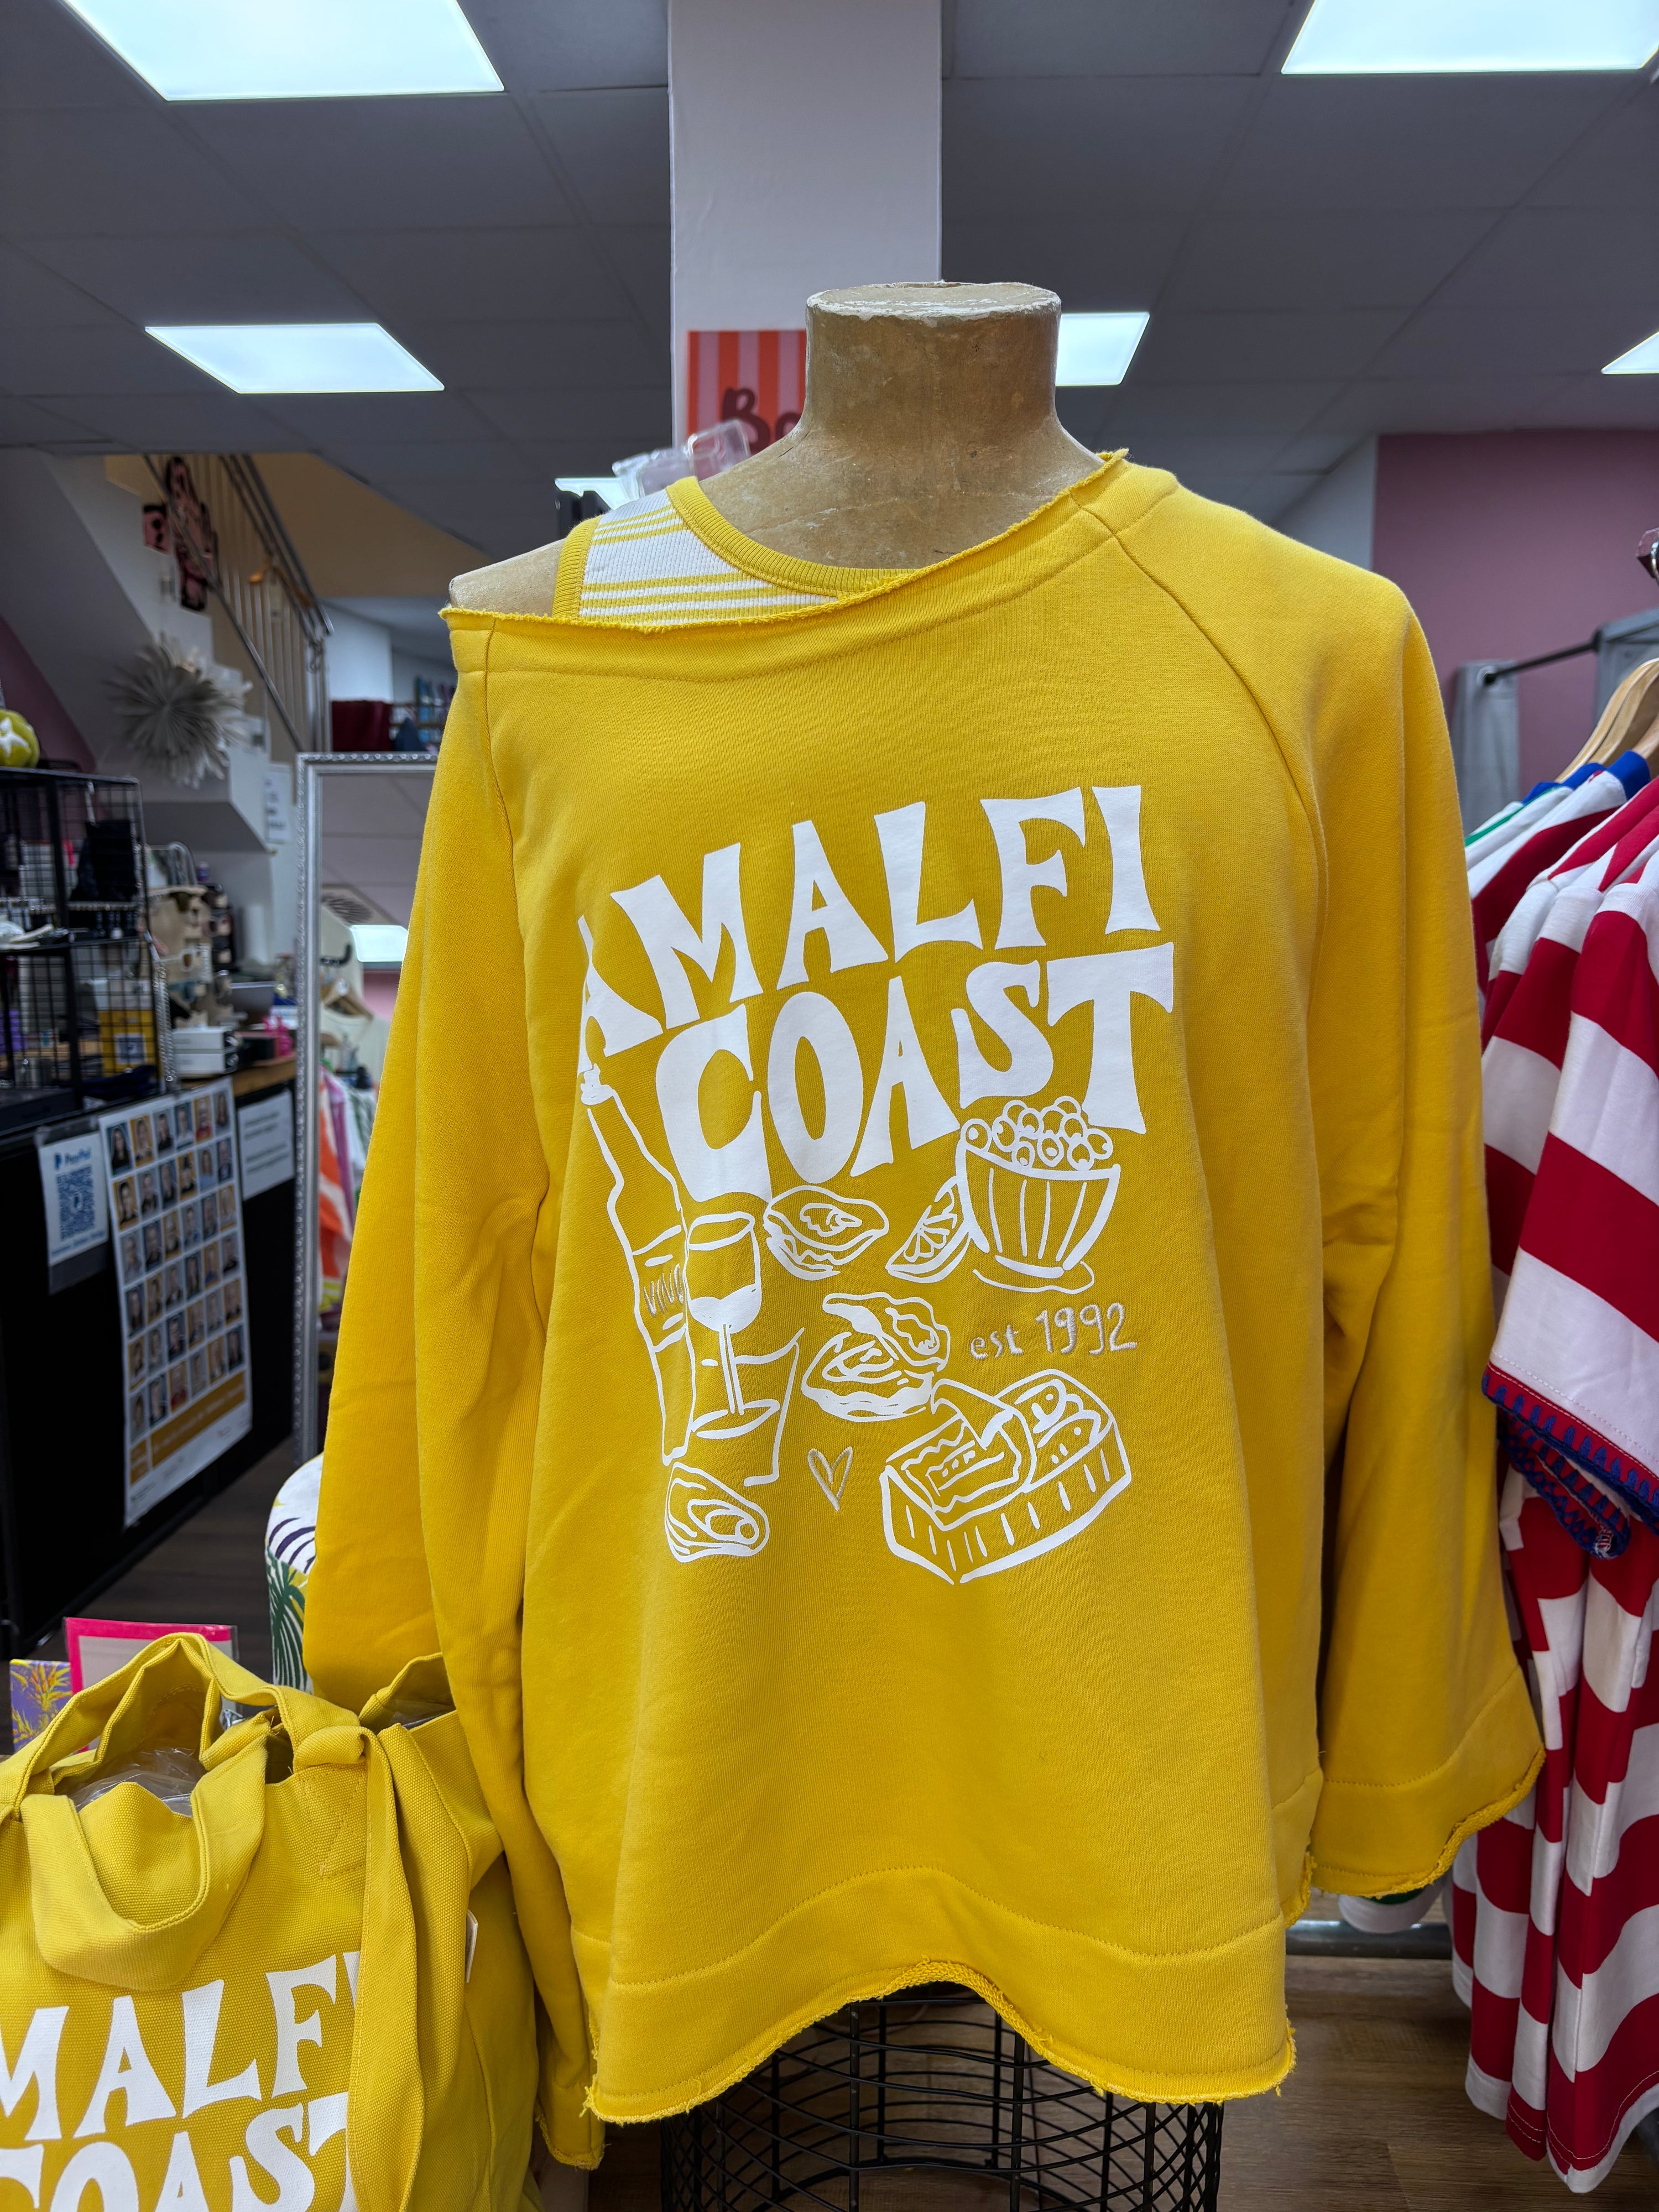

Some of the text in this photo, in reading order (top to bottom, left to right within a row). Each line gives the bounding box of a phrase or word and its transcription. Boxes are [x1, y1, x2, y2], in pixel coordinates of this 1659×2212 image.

[577, 785, 1160, 1073] AMALFI
[655, 942, 1174, 1204] COAST
[970, 1302, 1138, 1360] est 1992
[0, 1950, 360, 2141] MALF
